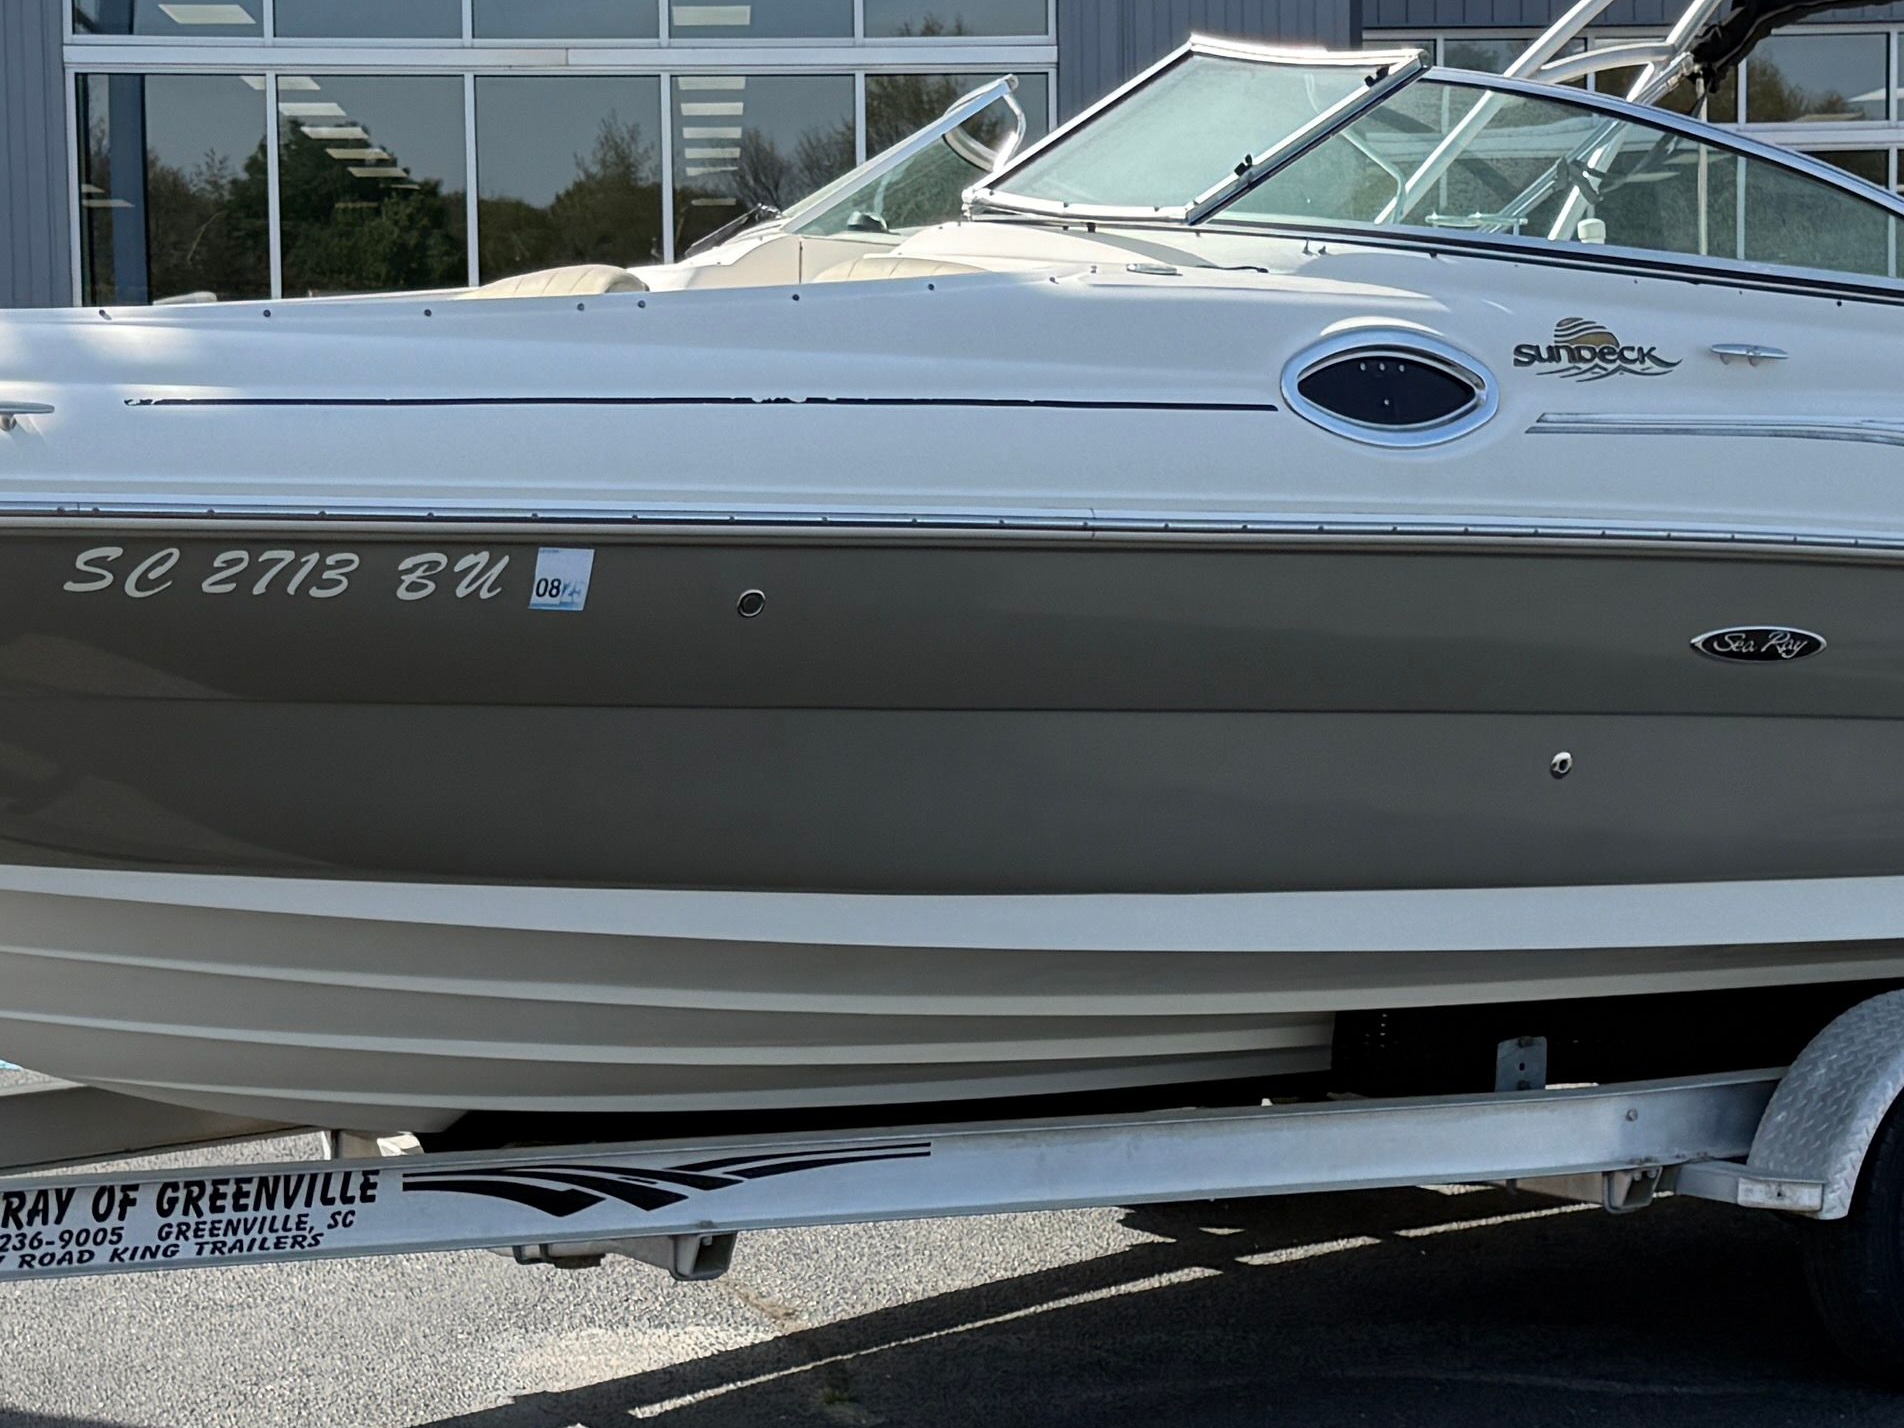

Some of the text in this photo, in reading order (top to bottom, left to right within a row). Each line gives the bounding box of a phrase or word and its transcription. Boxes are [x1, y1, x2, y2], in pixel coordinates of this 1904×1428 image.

[63, 546, 180, 598] SC
[201, 550, 360, 598] 2713
[396, 551, 510, 601] BU
[536, 578, 562, 598] 08
[1713, 631, 1809, 659] Sea Ray
[1, 1187, 77, 1231] RAY
[92, 1183, 140, 1223] OF
[156, 1169, 380, 1219] GREENVILLE
[157, 1213, 315, 1242] GREENVILLE,
[327, 1209, 356, 1230] SC
[18, 1249, 95, 1270] ROAD
[109, 1242, 180, 1264] KING
[194, 1233, 325, 1257] TRAILERS
